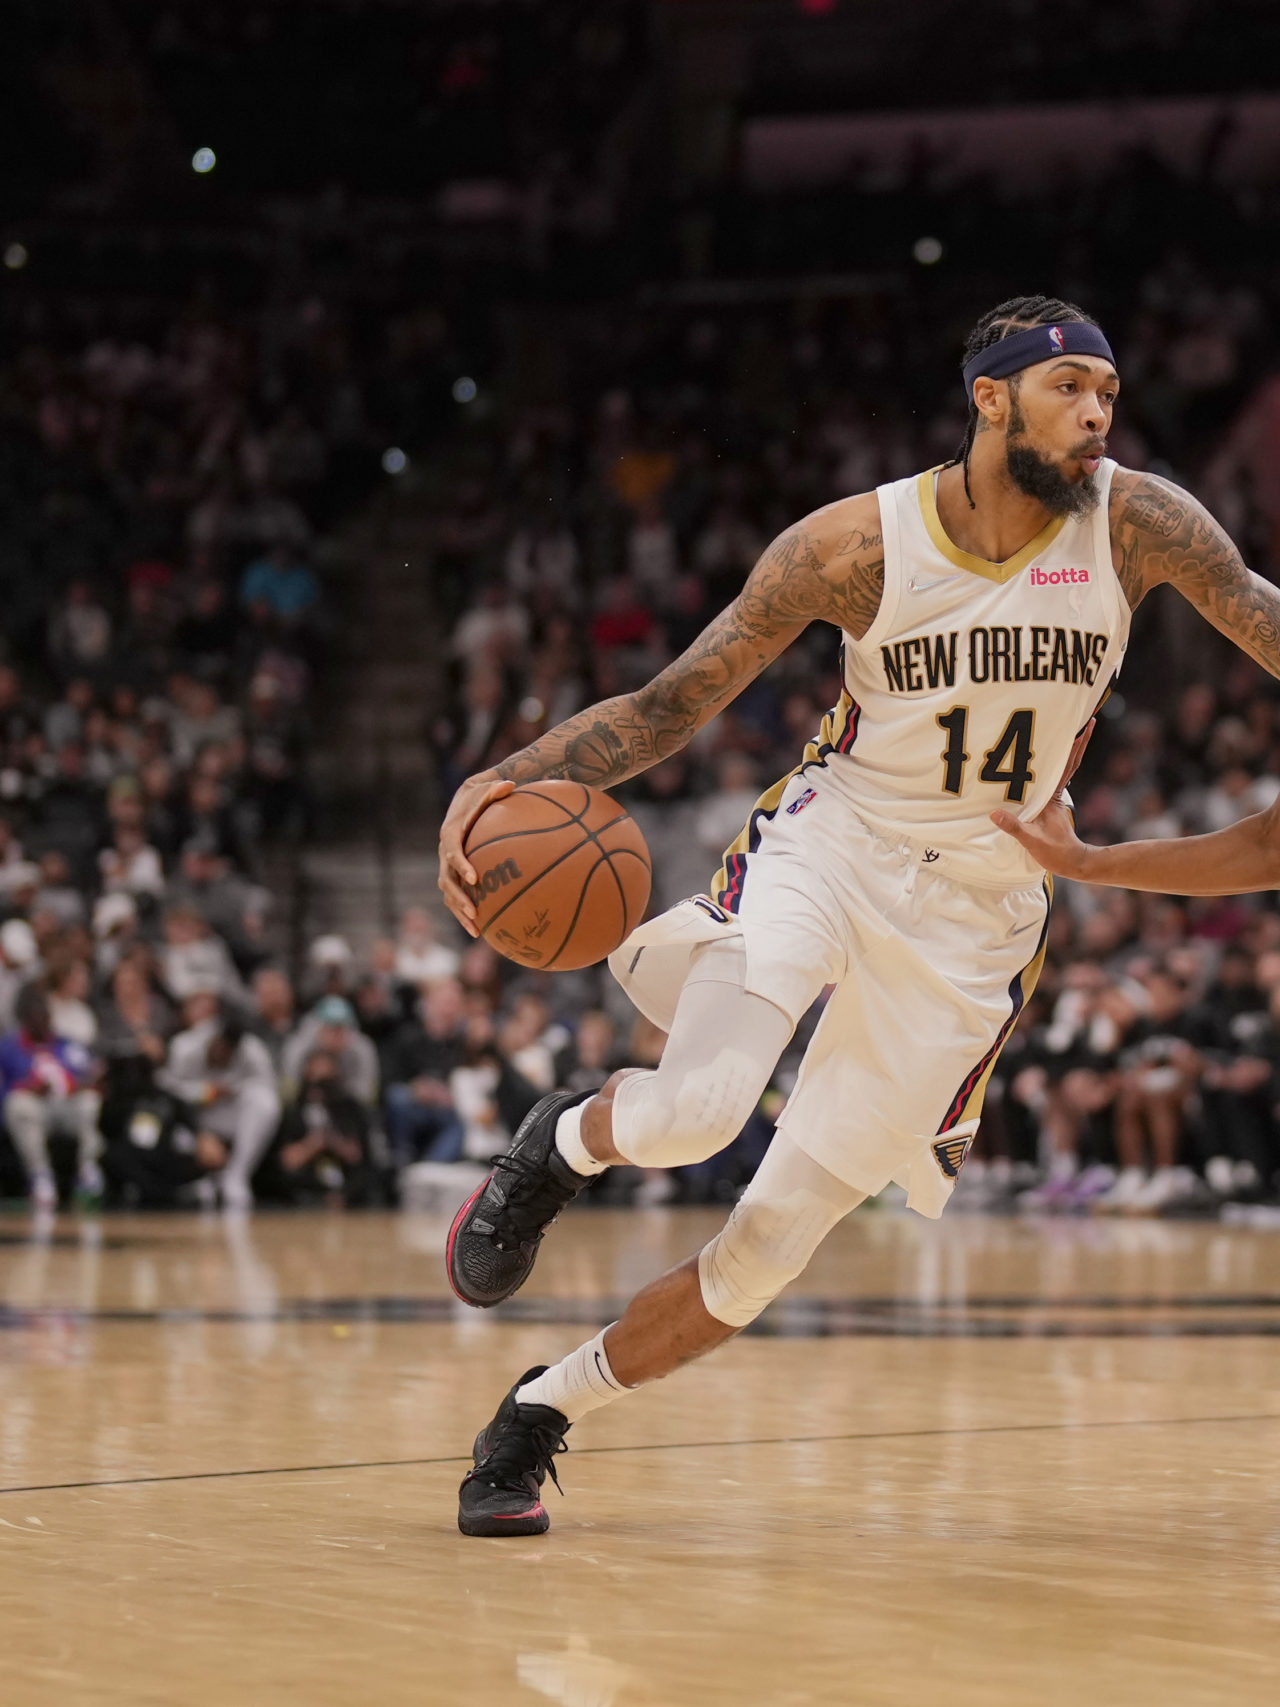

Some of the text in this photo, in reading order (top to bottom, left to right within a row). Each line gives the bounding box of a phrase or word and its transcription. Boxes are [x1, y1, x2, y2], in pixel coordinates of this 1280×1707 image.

[1030, 568, 1090, 586] ibotta
[880, 625, 1110, 692] NEW ORLEANS
[935, 705, 1036, 805] 14
